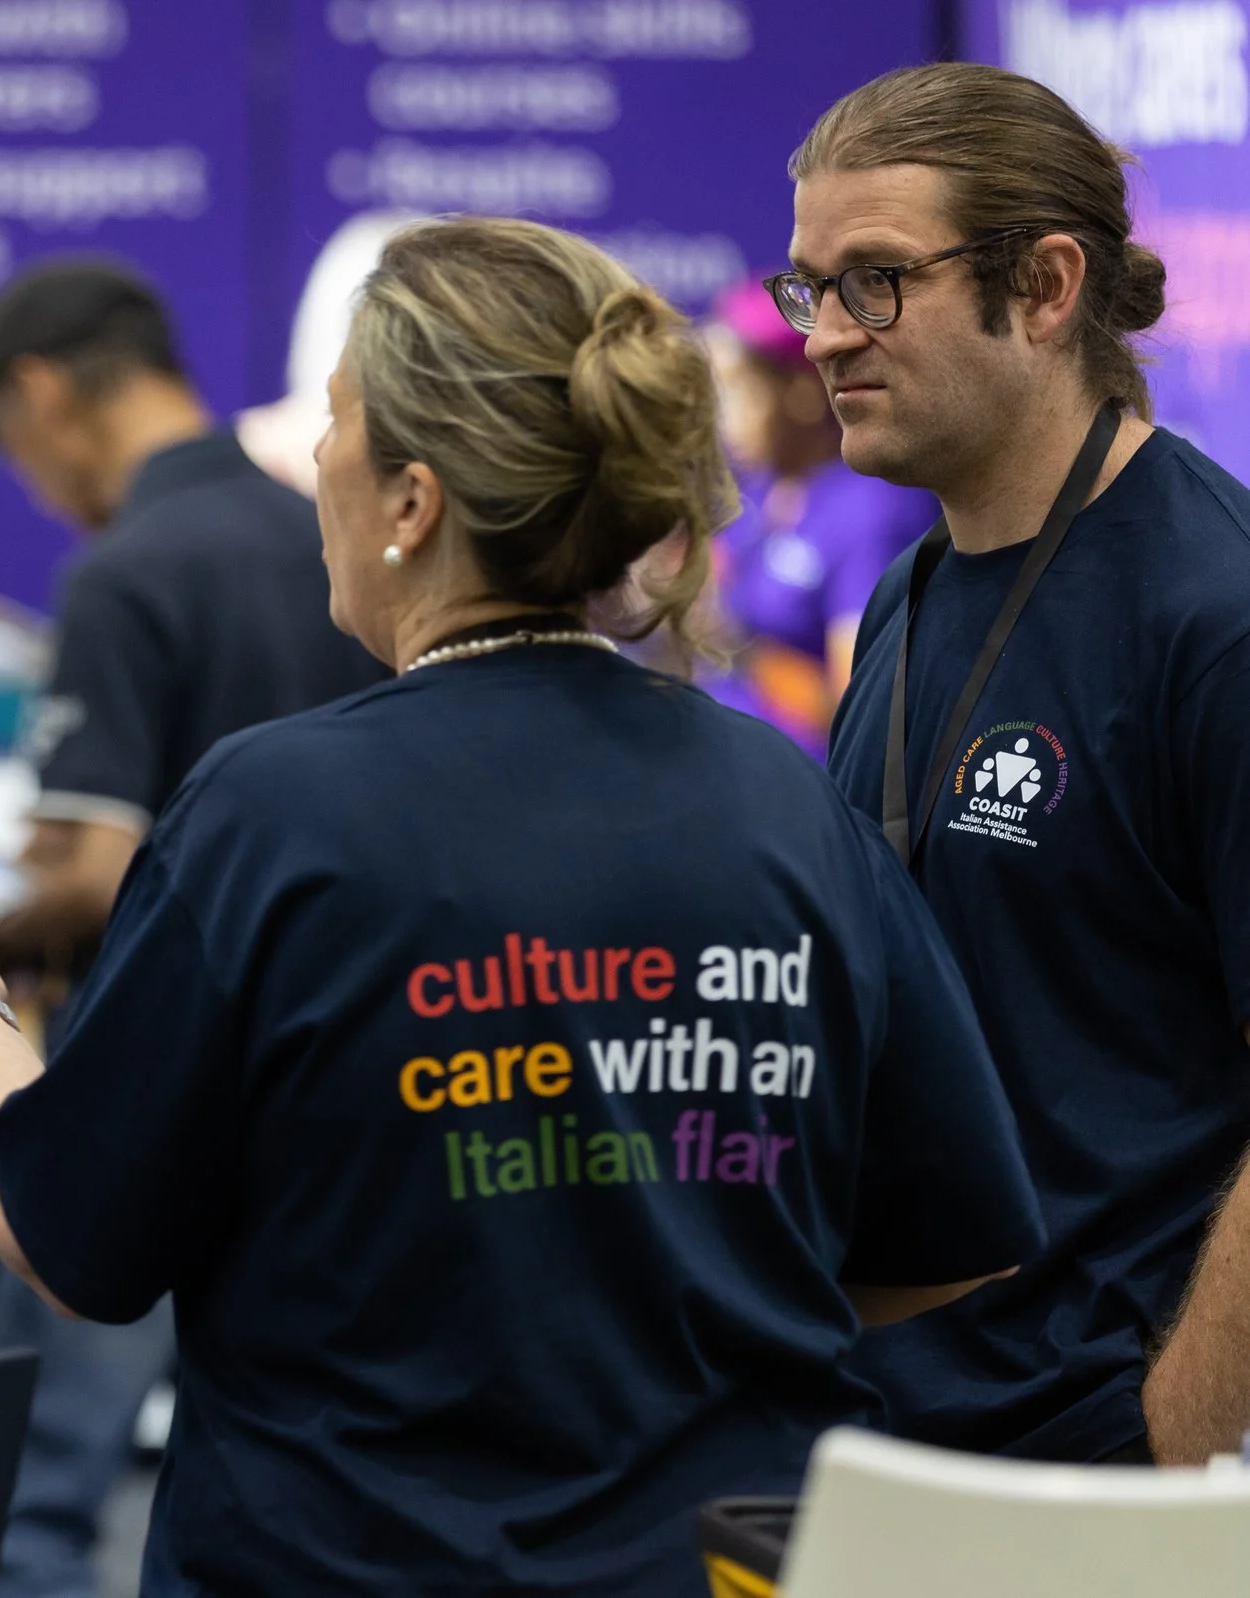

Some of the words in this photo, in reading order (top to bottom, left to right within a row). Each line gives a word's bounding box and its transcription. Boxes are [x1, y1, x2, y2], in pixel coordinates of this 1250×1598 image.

[984, 721, 1037, 738] LANGUAGE
[1036, 725, 1066, 761] CULTURE
[963, 736, 984, 762] CARE
[954, 765, 965, 794] AGED
[1043, 762, 1068, 815] HERITAGE
[960, 812, 982, 825] Italian
[983, 817, 1027, 835] Assistance
[969, 797, 1028, 822] COASIT
[948, 820, 988, 835] Association
[990, 828, 1038, 848] Melbourne
[407, 933, 676, 1018] culture
[696, 934, 812, 1007] and
[398, 1042, 573, 1112] care
[589, 1018, 739, 1094] with
[751, 1041, 816, 1099] an
[445, 1114, 660, 1199] Italian
[671, 1109, 795, 1187] flair
